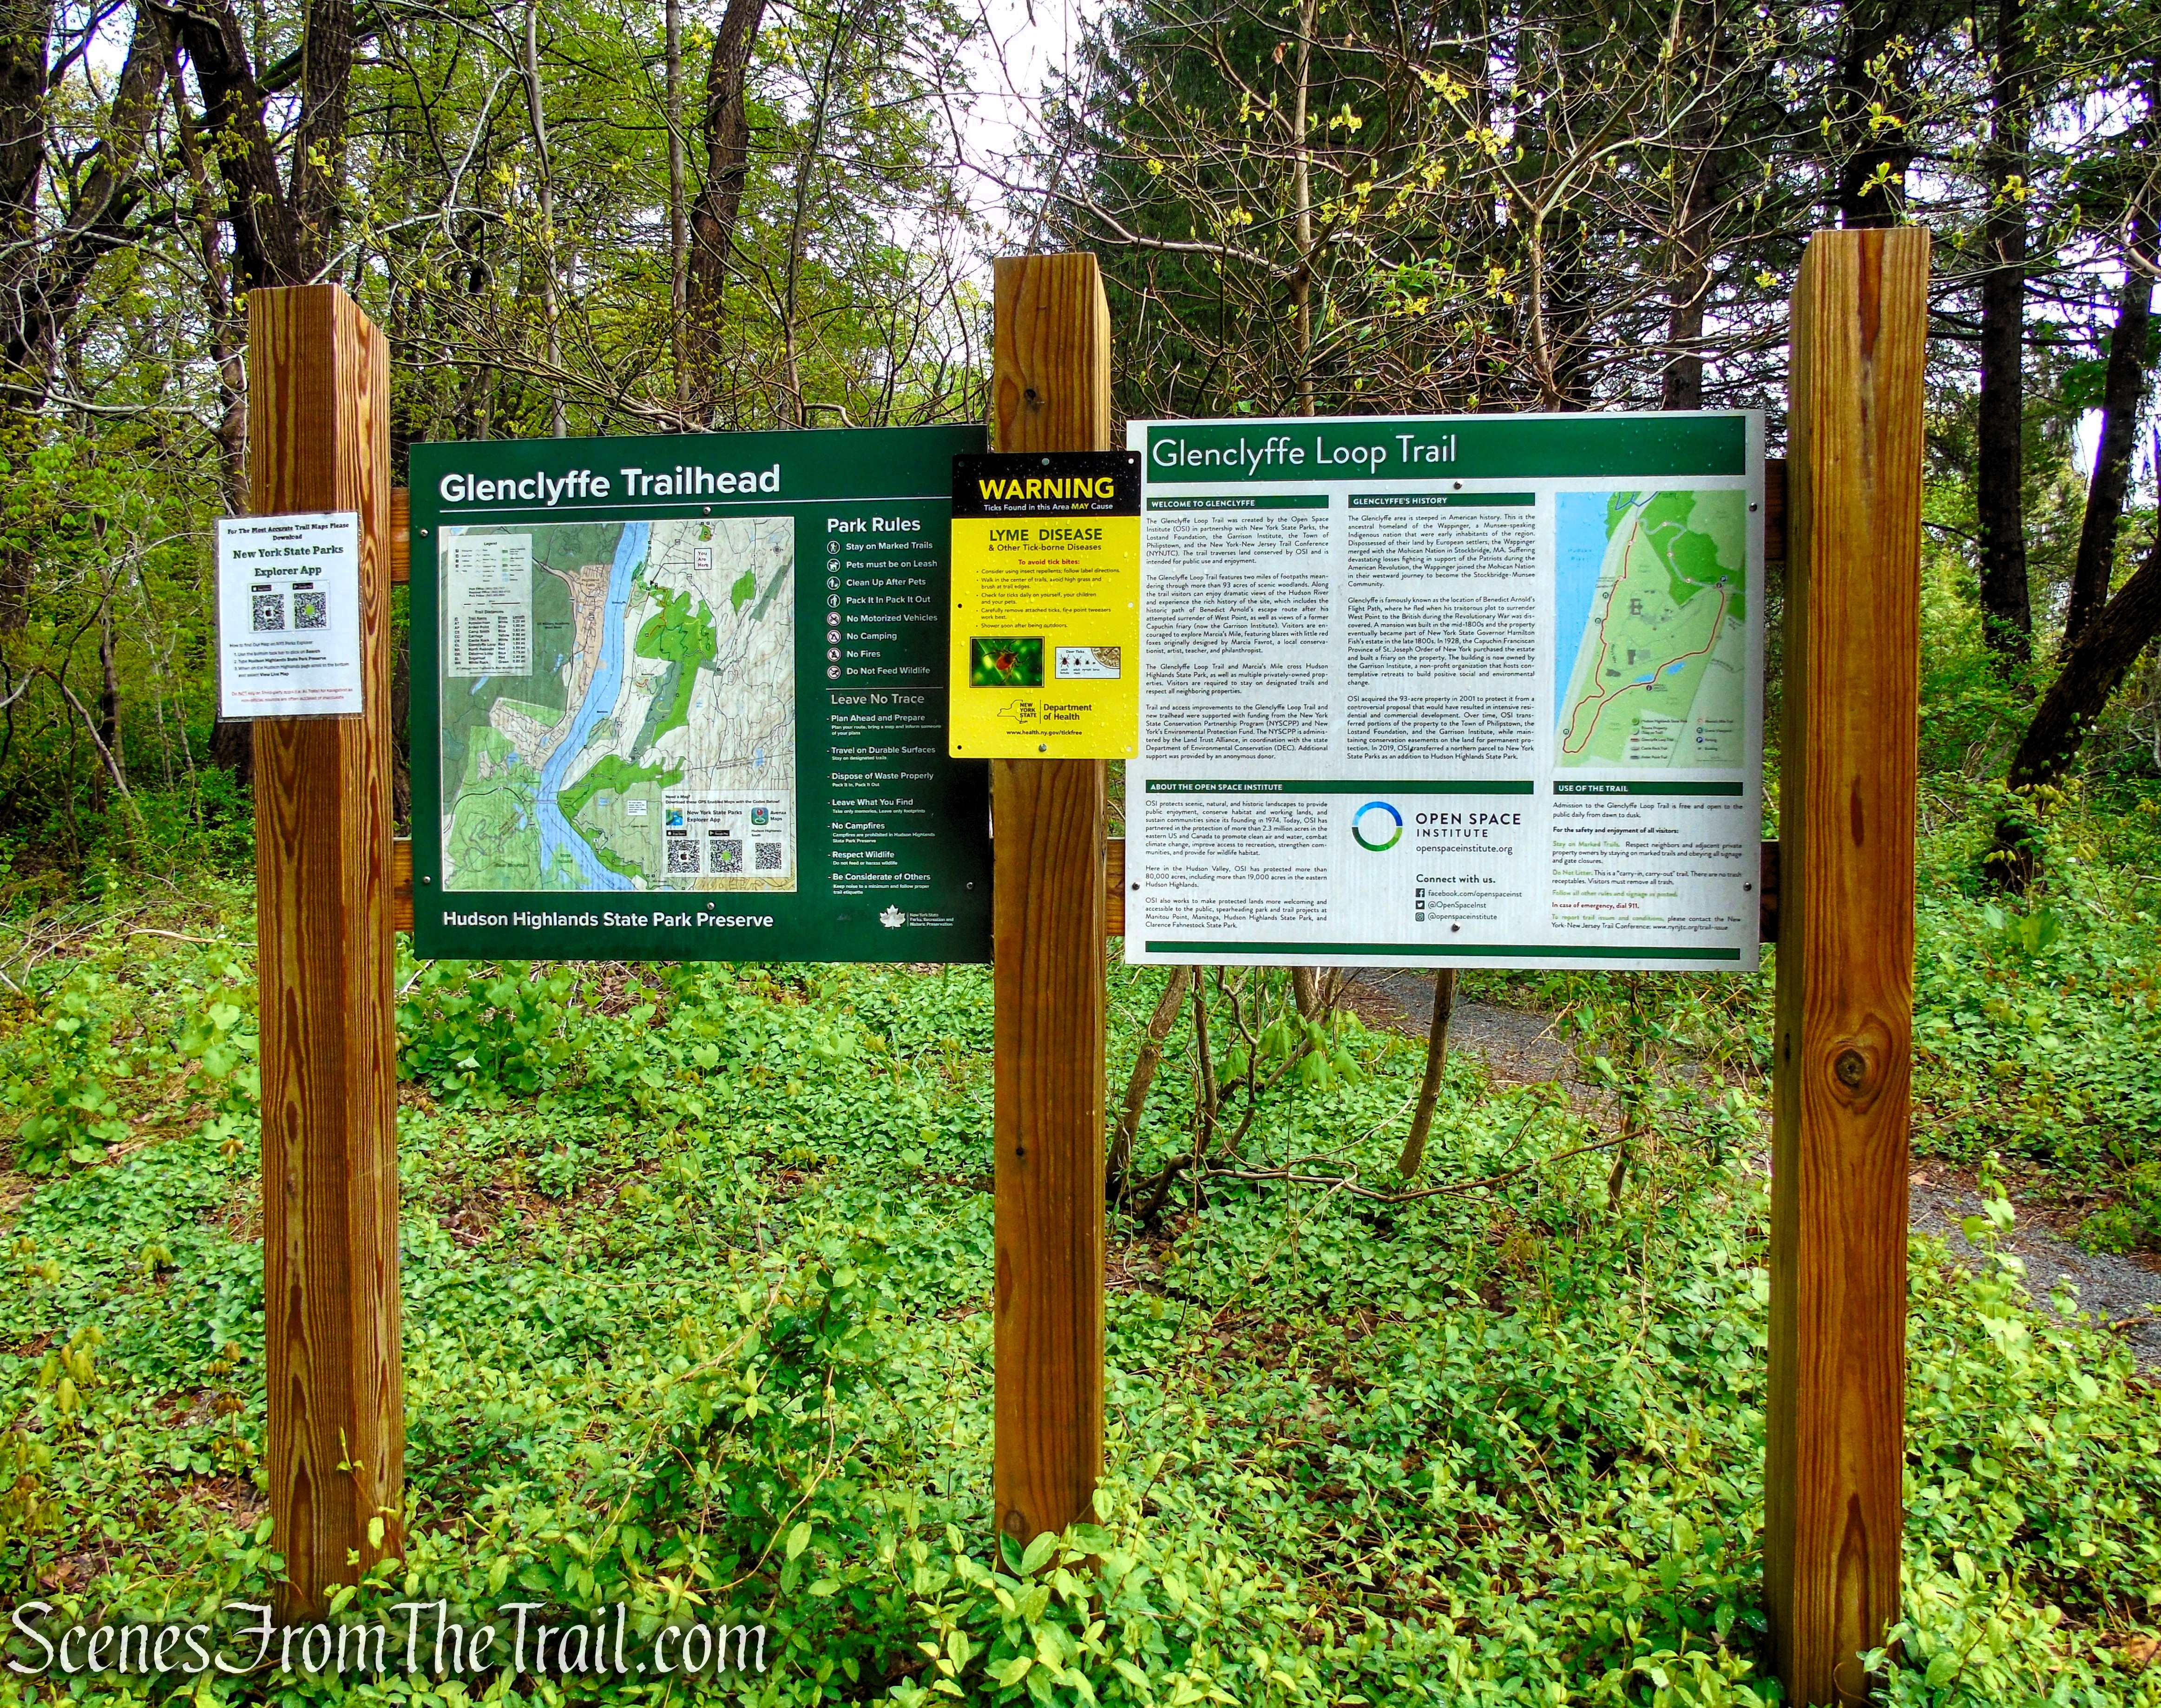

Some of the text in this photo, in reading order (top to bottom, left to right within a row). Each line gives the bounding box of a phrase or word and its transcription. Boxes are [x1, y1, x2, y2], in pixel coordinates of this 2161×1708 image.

[1153, 434, 1455, 475] Glenclyffe Loop Trail
[441, 464, 779, 504] Glenclyffe Trailhead
[979, 478, 1113, 499] WARNING
[828, 517, 920, 532] Park Rules
[990, 528, 1102, 541] LYME DISEASE
[258, 548, 282, 557] York
[313, 545, 343, 554] Parks
[255, 566, 321, 578] Explorer App
[832, 694, 924, 704] Leave No Trace
[1416, 813, 1520, 825] OPEN SPACE
[1417, 829, 1487, 837] INSTITUTE
[1417, 844, 1512, 855] openspaceinstitute.org
[1417, 874, 1456, 882] Connect
[1428, 890, 1522, 899] facebook.com/openspaceinst
[1428, 901, 1486, 910] @OpenSpaceInst
[444, 912, 773, 929] Hudson Highlands State Park Preserve
[1428, 913, 1497, 921] @openspaceinstitute
